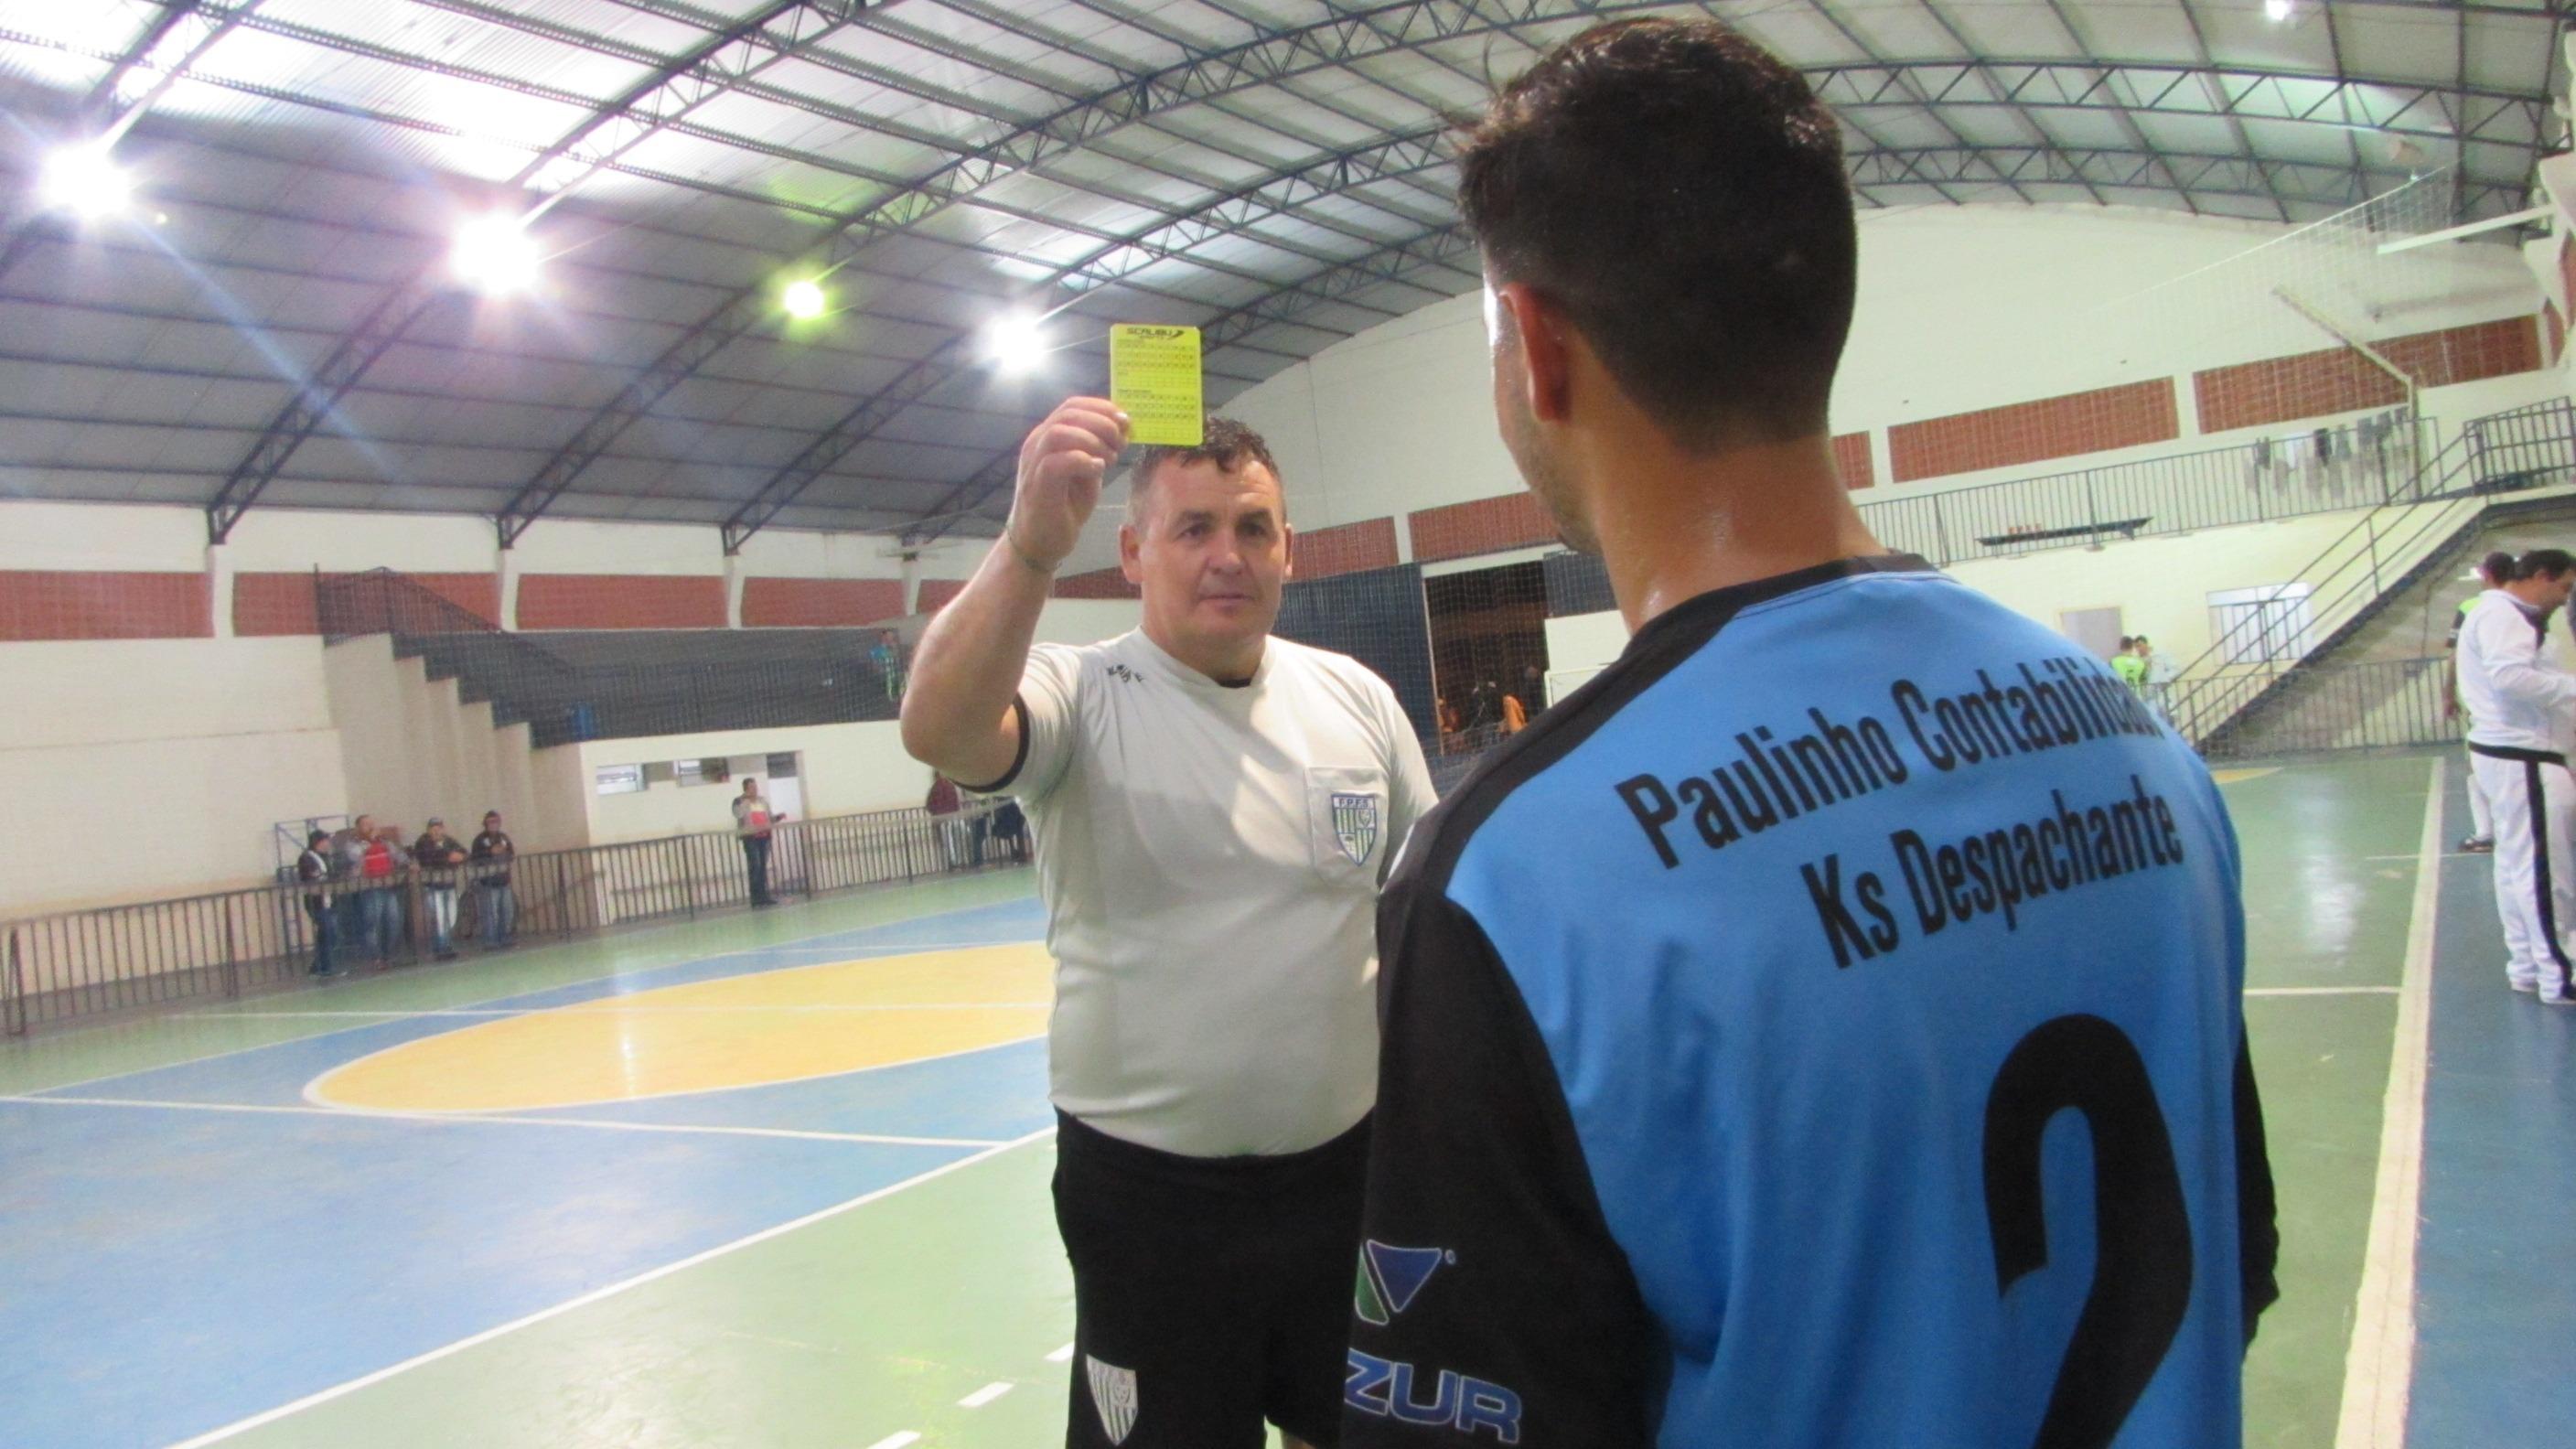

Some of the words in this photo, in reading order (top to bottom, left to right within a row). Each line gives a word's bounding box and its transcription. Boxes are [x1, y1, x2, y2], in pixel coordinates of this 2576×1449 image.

[1615, 707, 1908, 869] Paulinho
[1799, 853, 1901, 970] Ks
[1890, 774, 2184, 935] Despachante
[1983, 1014, 2194, 1449] 2
